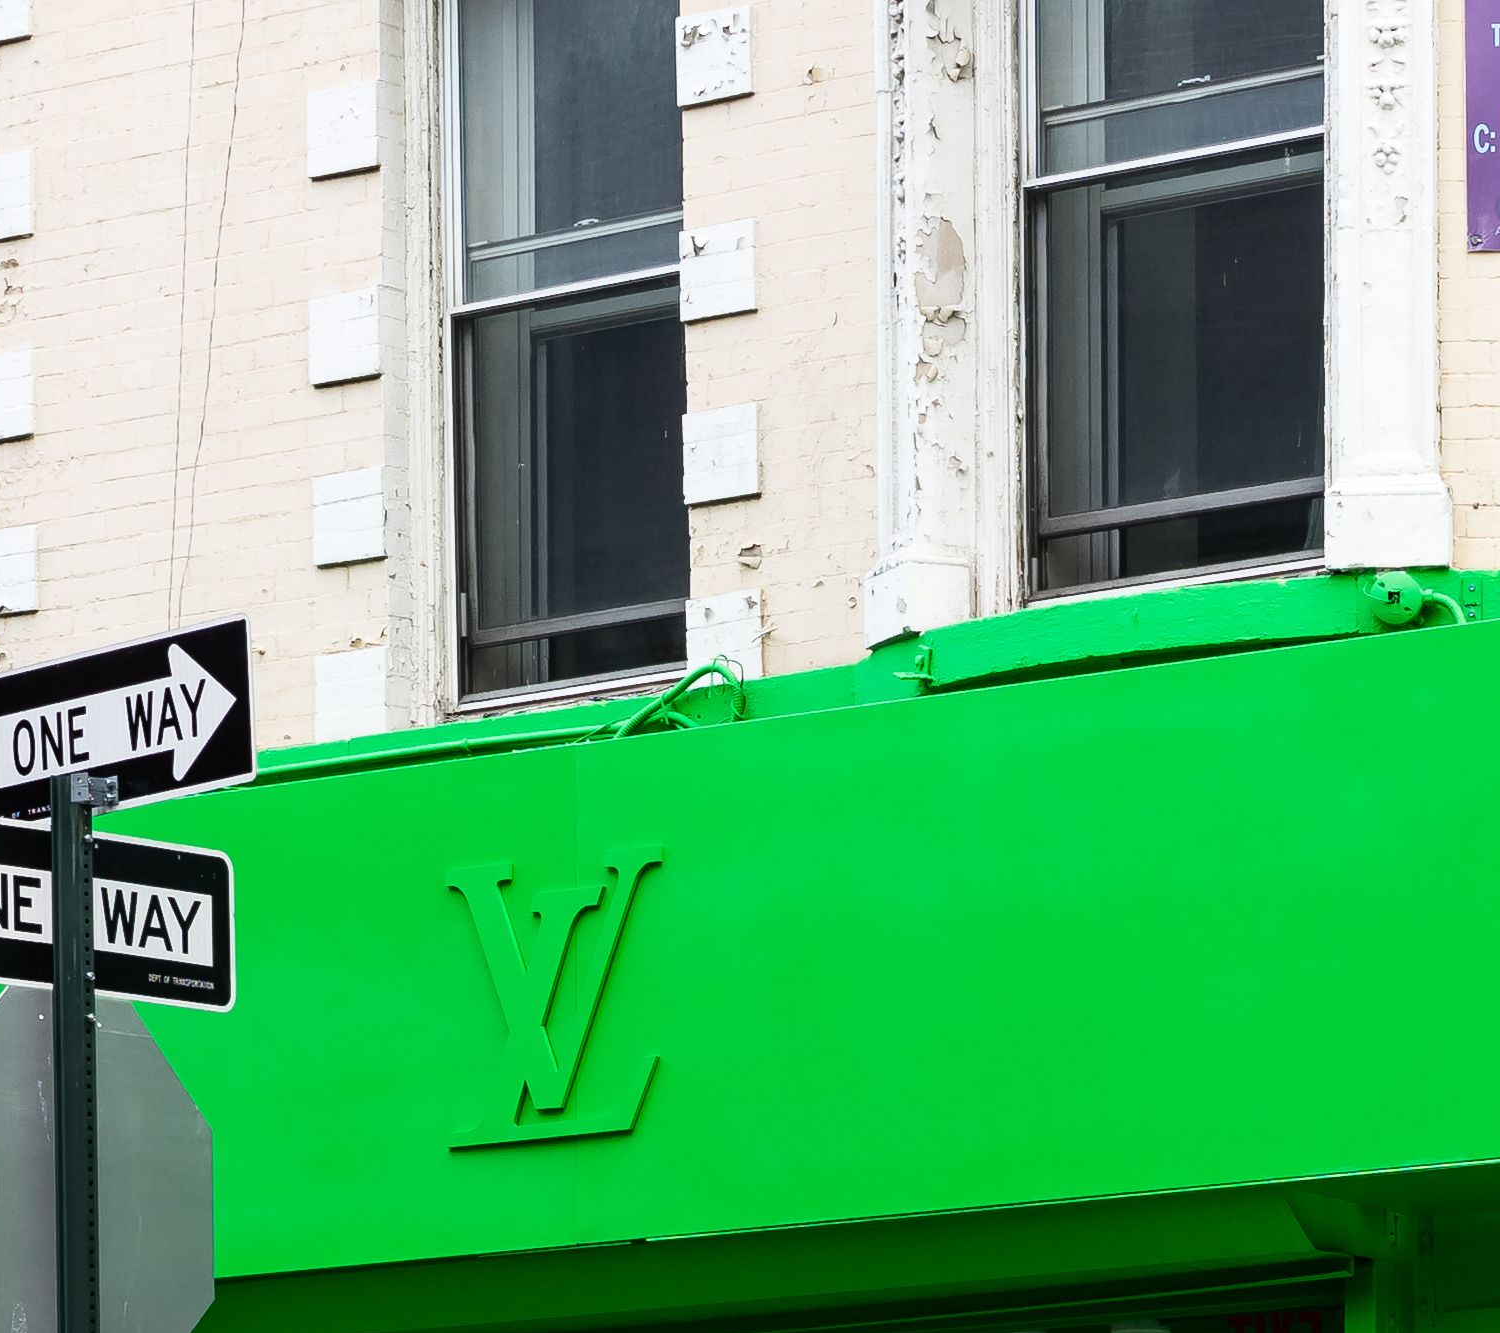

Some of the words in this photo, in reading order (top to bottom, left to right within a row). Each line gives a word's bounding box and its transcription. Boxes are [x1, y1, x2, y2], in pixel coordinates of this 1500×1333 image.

[1473, 123, 1497, 154] C:
[11, 704, 90, 778] ONE
[125, 677, 207, 752] WAY
[100, 886, 202, 956] WAY
